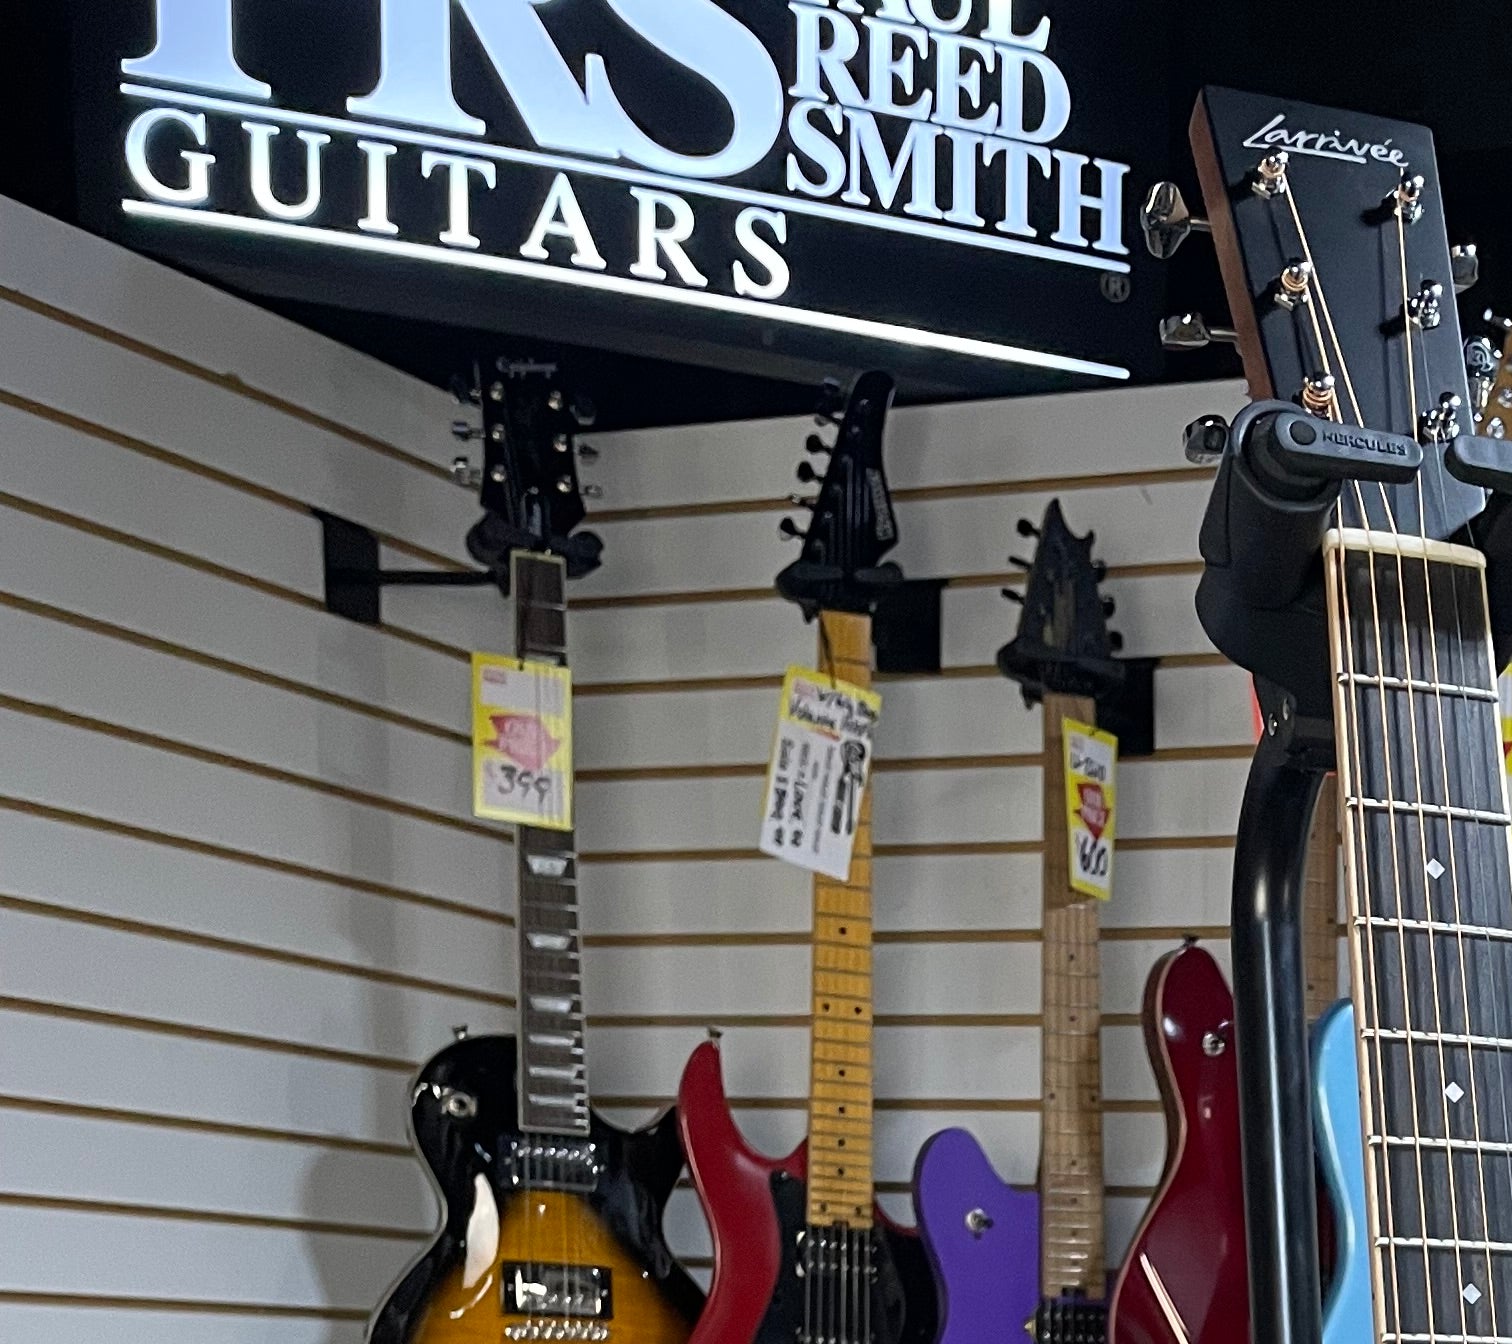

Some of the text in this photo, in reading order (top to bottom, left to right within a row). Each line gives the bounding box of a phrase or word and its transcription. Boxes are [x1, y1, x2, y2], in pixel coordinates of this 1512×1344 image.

[788, 1, 1071, 144] REED
[1243, 114, 1409, 167] Larrivée
[123, 106, 792, 300] GUITARS
[786, 97, 1131, 255] SMITH
[1322, 430, 1407, 456] HERCULES
